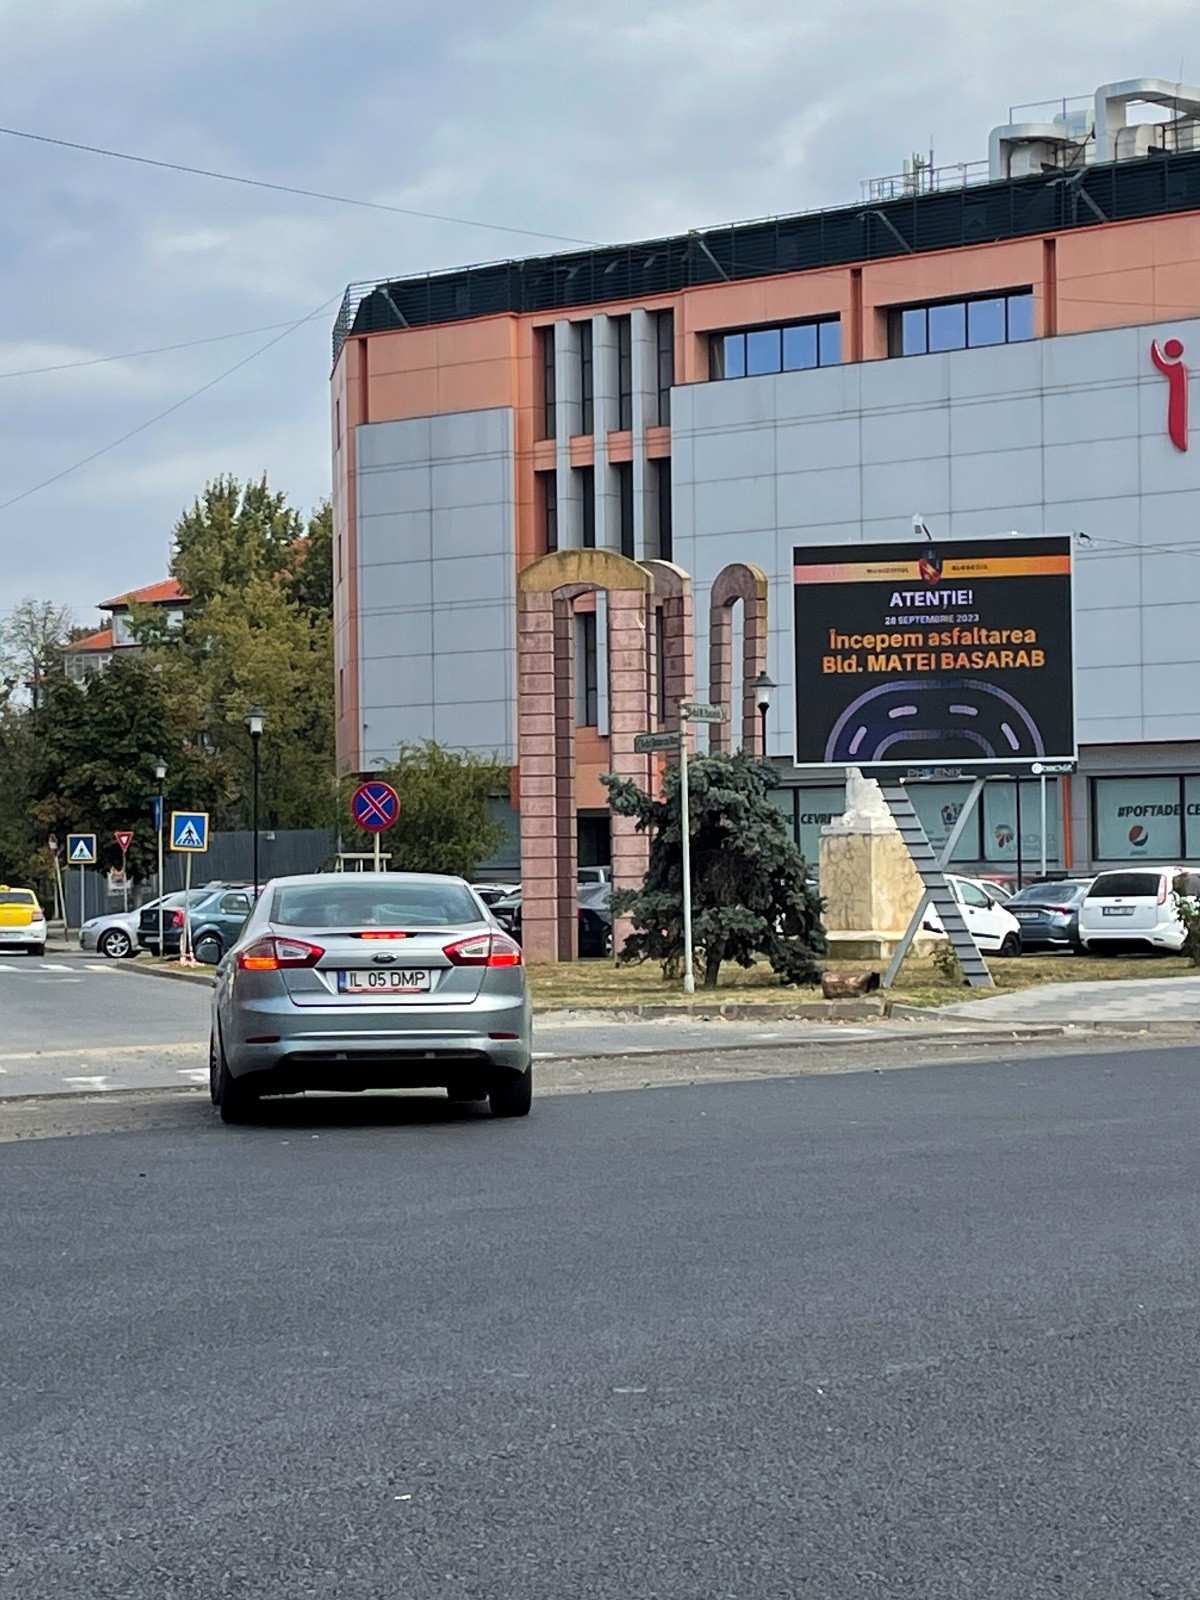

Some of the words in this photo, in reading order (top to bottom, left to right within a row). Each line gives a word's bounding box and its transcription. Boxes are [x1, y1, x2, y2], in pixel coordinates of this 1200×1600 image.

[889, 590, 974, 609] ATENȚIE!
[884, 616, 897, 626] 28
[898, 615, 955, 625] SEPTEMBRIE
[956, 613, 980, 623] 2023
[829, 628, 923, 652] Începem
[927, 626, 1036, 646] asfaltarea
[822, 654, 864, 674] Bld.
[867, 652, 937, 673] MATEI
[940, 649, 1046, 671] BASARAB
[349, 971, 363, 987] IL
[368, 971, 387, 987] 05
[390, 971, 426, 987] DMP
